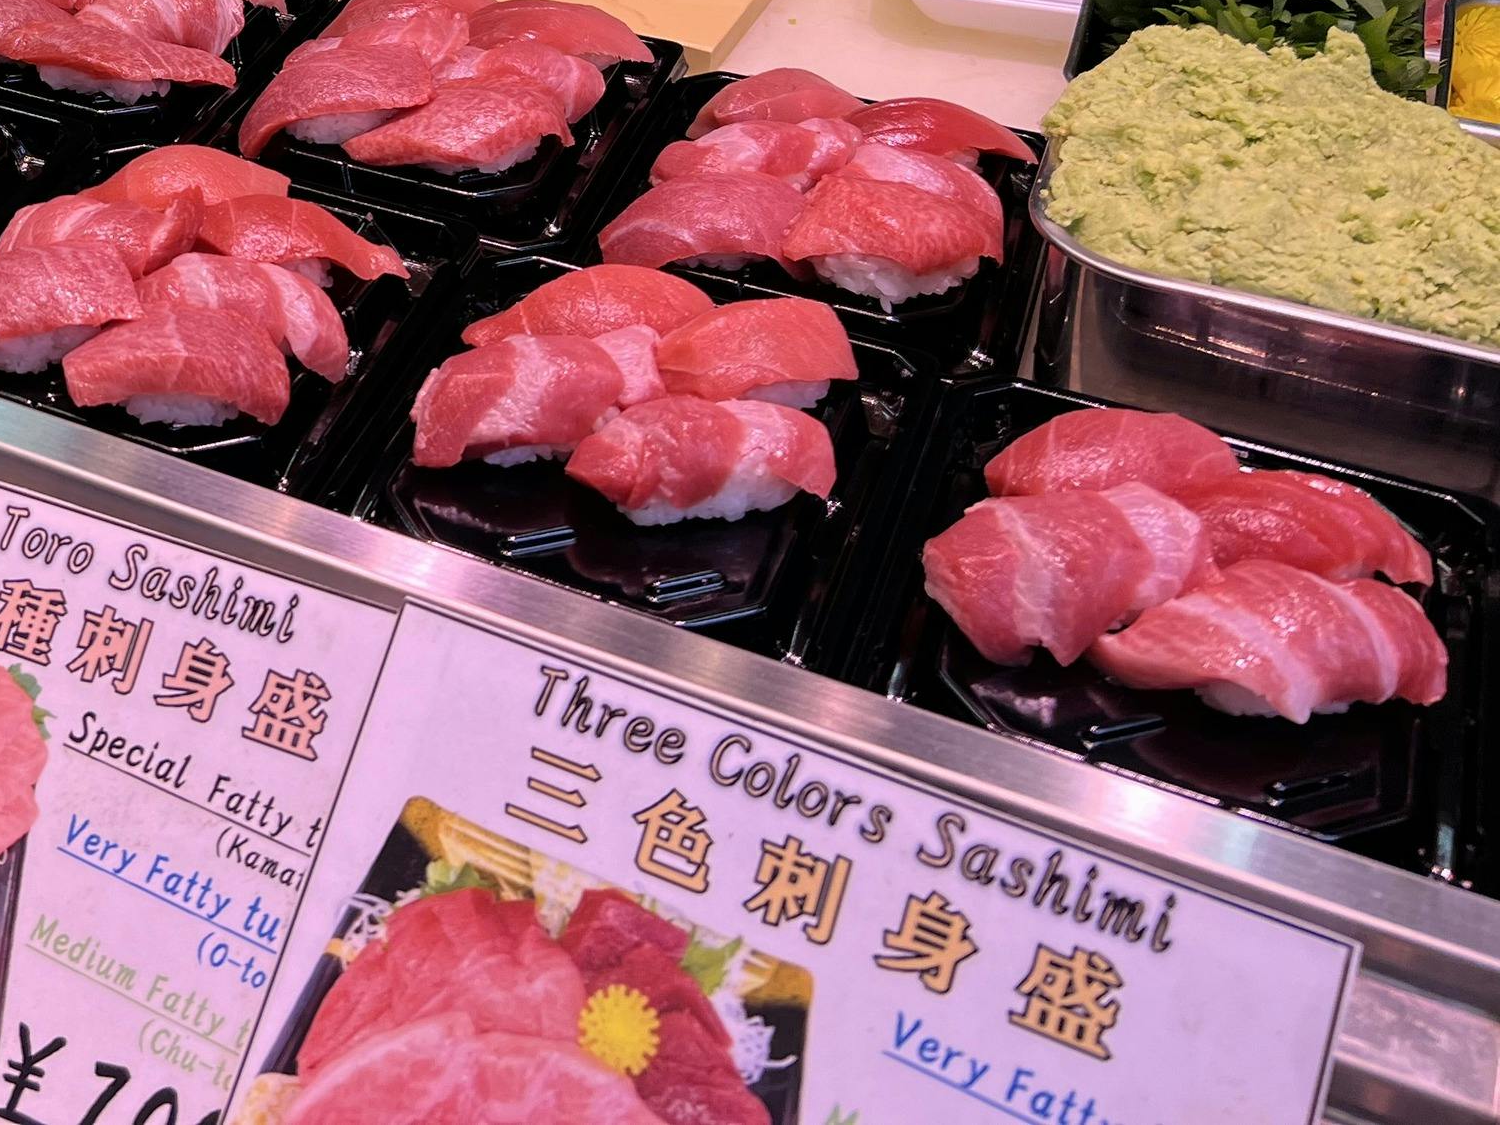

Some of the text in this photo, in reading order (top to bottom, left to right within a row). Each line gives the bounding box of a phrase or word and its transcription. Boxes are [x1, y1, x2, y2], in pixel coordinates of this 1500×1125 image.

[0, 506, 94, 575] Toro
[109, 544, 301, 645] Sashimi
[67, 710, 192, 789] Special
[208, 775, 293, 837] Fatty
[534, 665, 1179, 955] Three Colors Sashimi
[66, 814, 137, 874] Very
[145, 854, 232, 921] Fatty
[504, 745, 1124, 1061] 三色刺身盛
[30, 914, 137, 991] Medium
[146, 974, 225, 1040] Fatty
[892, 1011, 1110, 1125] Very Fatt
